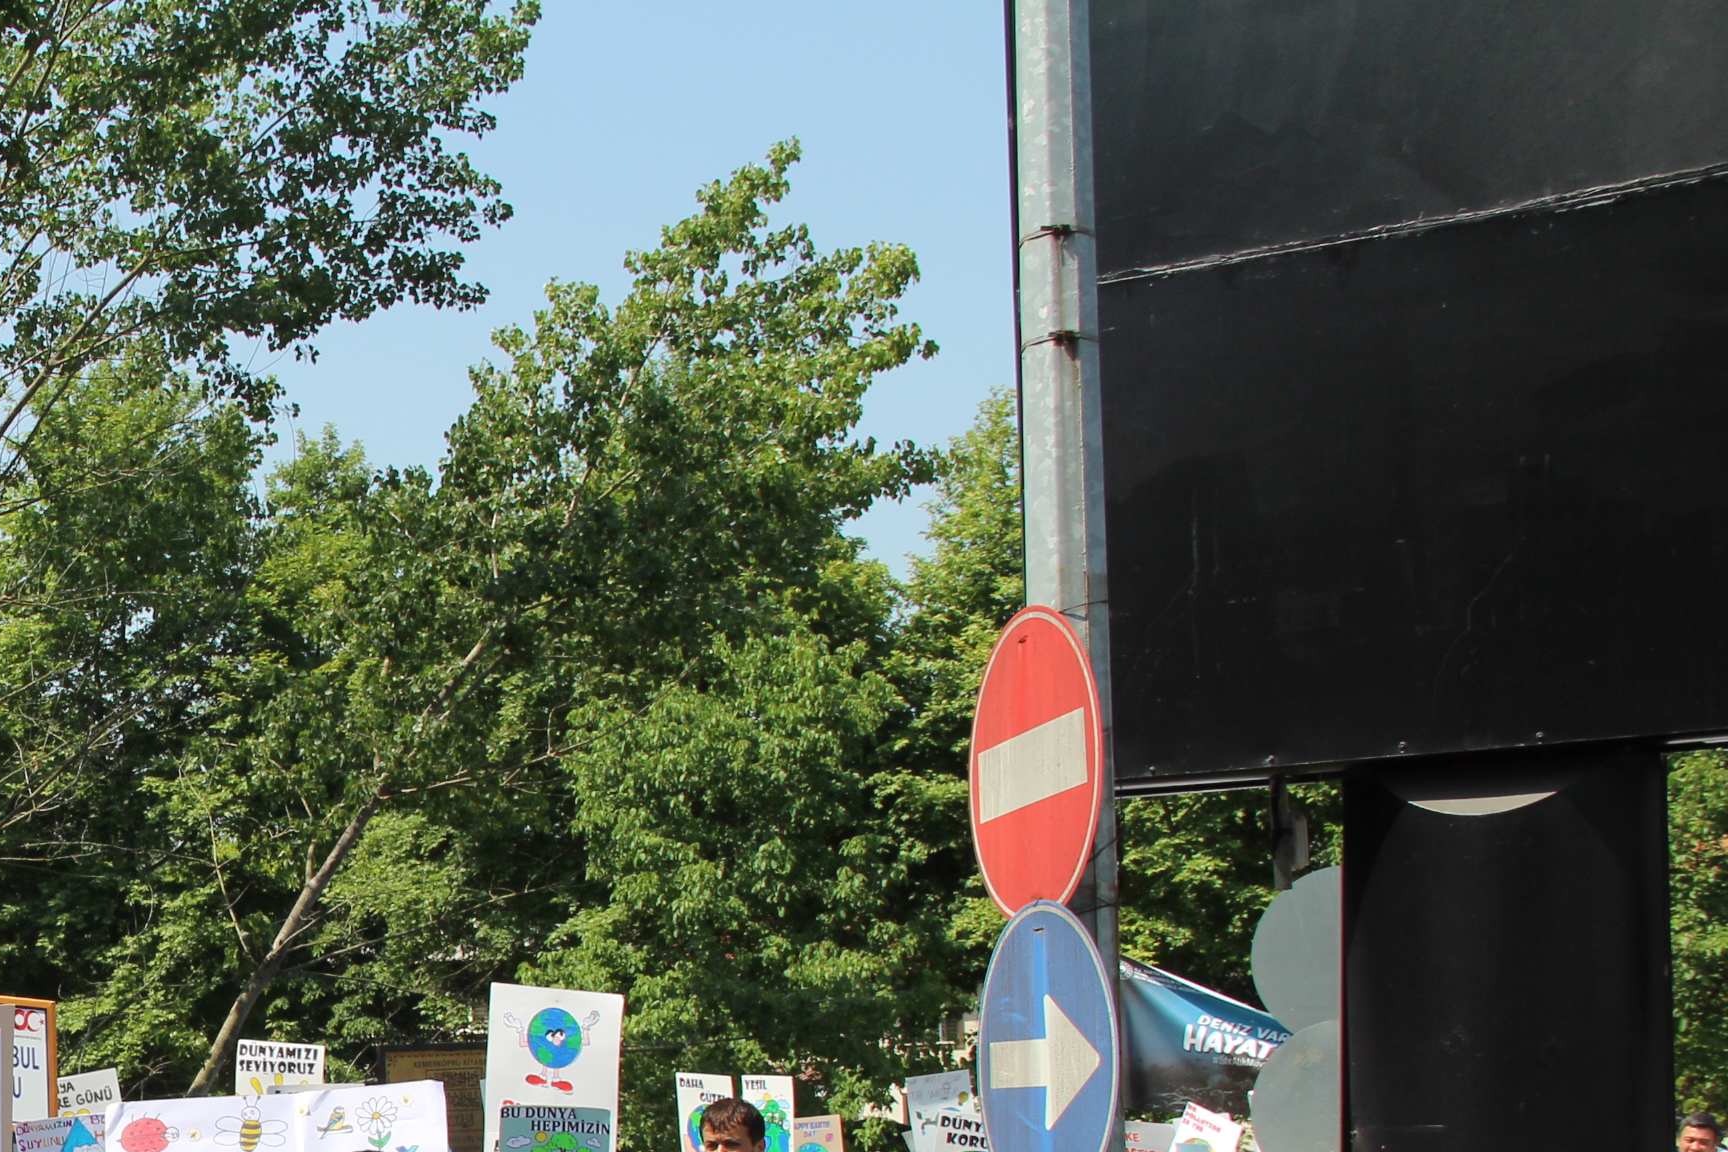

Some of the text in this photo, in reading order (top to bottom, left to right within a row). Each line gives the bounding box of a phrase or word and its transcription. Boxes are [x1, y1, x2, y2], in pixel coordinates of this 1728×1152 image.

[1197, 1014, 1252, 1036] DENİZ
[239, 1043, 318, 1061] DÜNYAMIZI
[239, 1060, 316, 1076] SEVİYORUZ
[679, 1077, 705, 1089] DAHA
[744, 1078, 768, 1092] YEŞİL
[75, 1088, 113, 1106] GÜNÜ
[501, 1106, 521, 1119] BU
[530, 1119, 611, 1135] HEPİMİZİN
[941, 1114, 984, 1133] DÜNY
